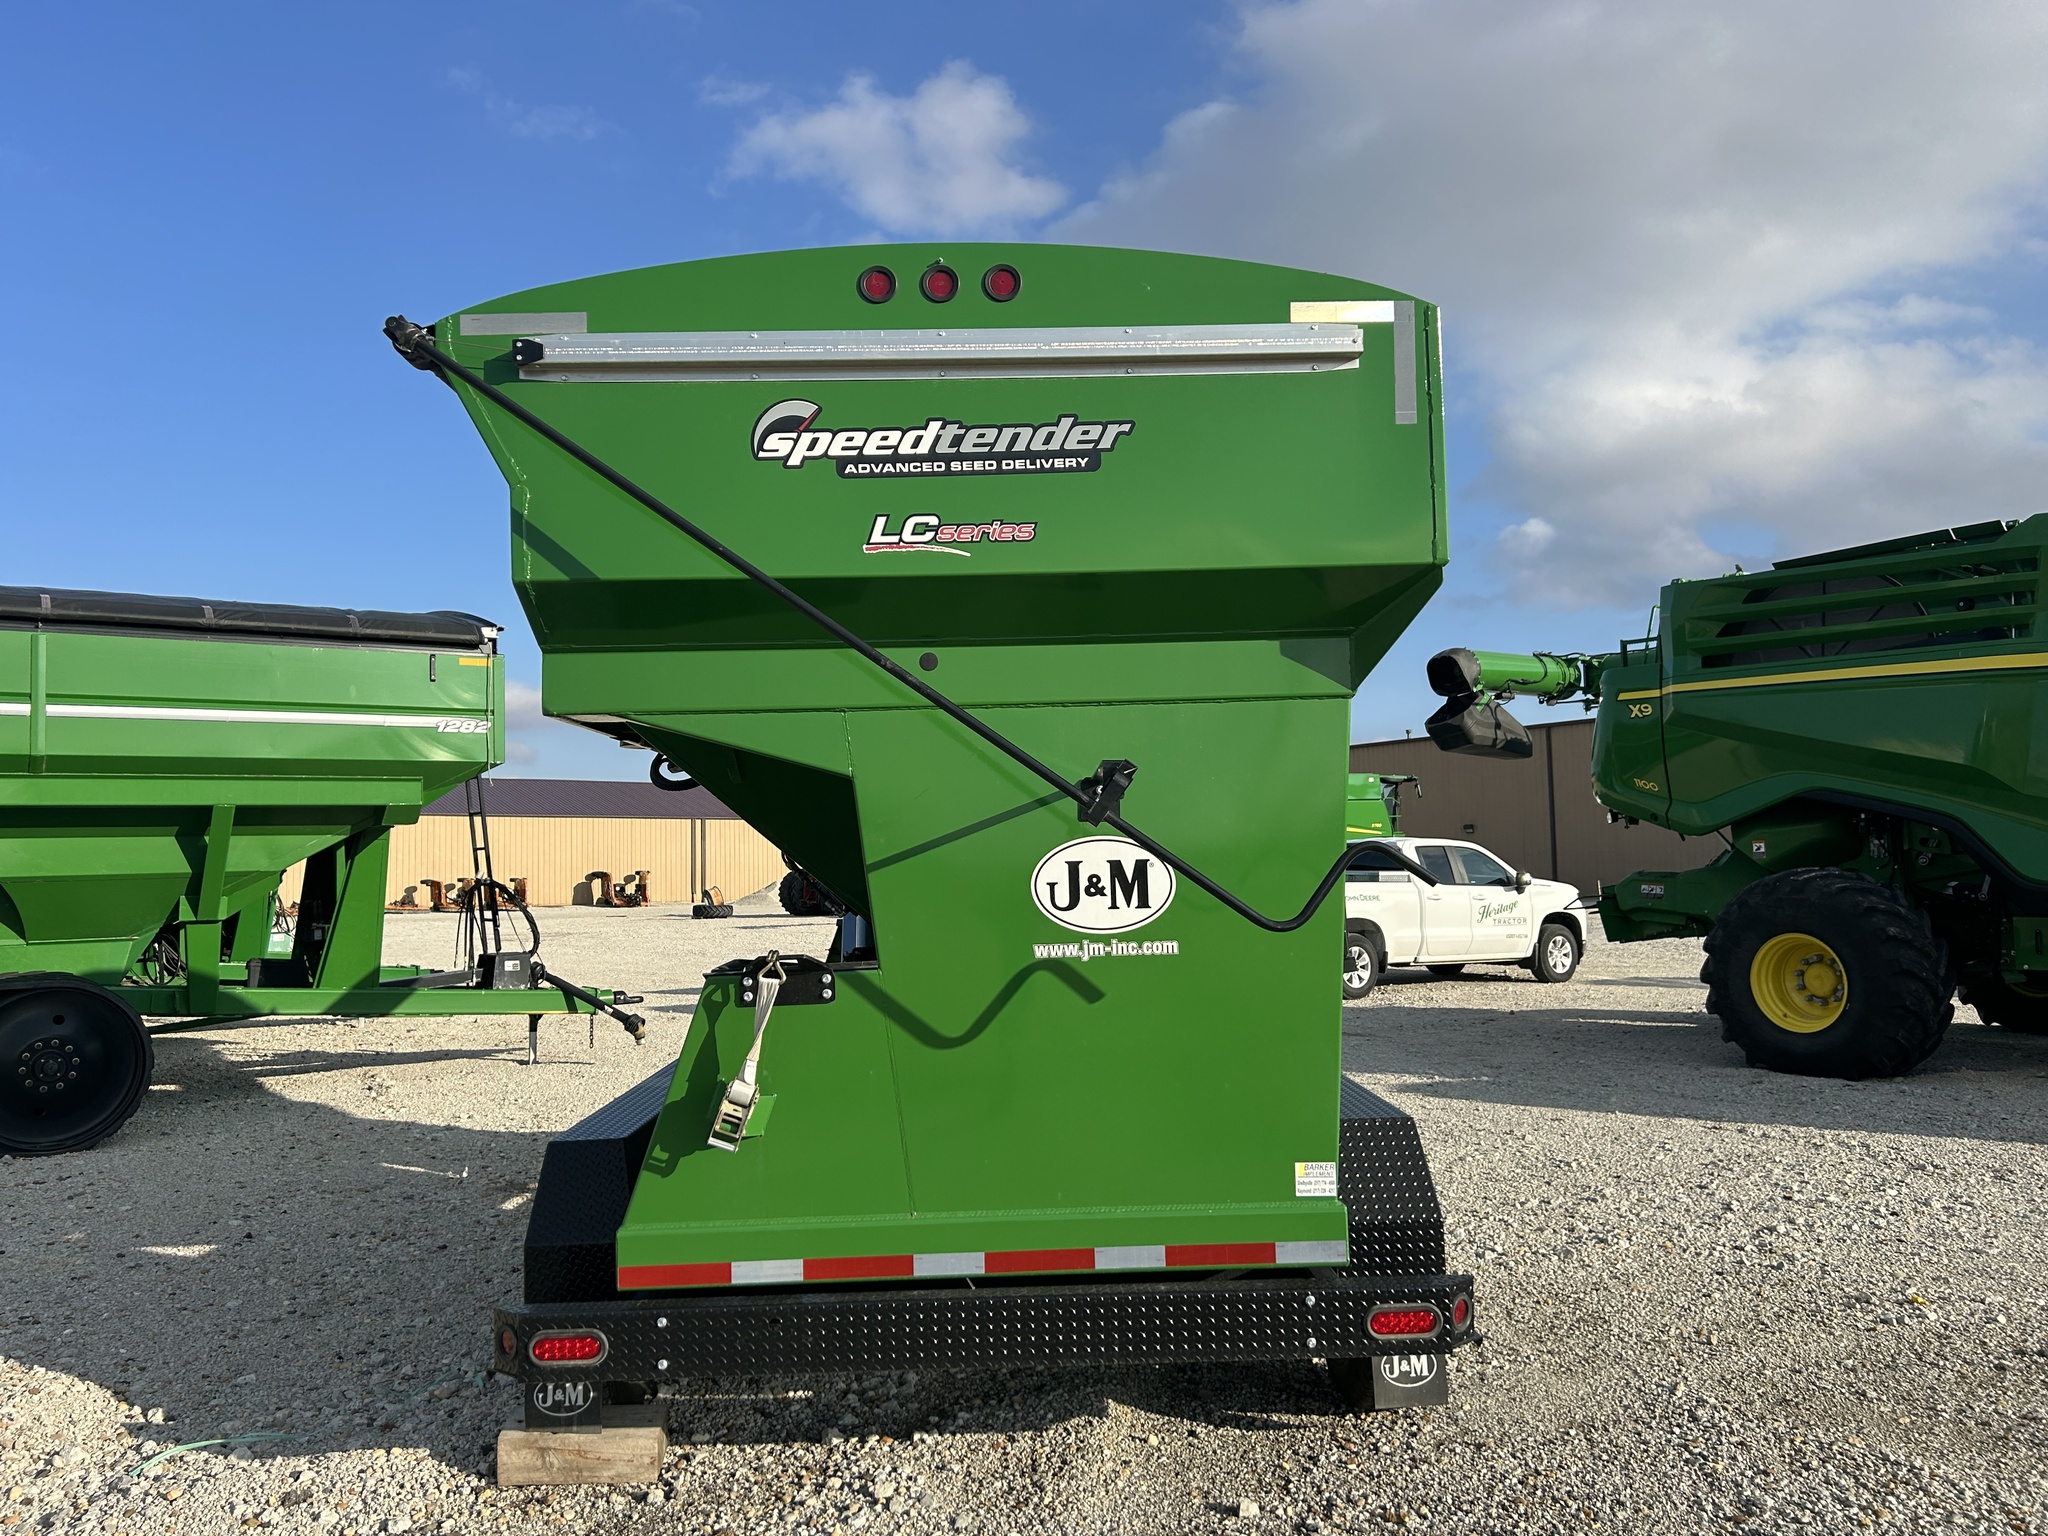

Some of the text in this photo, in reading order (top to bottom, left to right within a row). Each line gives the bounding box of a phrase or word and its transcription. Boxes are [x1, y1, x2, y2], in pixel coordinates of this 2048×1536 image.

[844, 457, 1090, 474] ADVANCED SEED DELIVERY
[1628, 703, 1653, 718] X9
[436, 719, 492, 734] 1282
[1633, 777, 1659, 791] 1100
[1046, 858, 1152, 912] J&M
[1477, 900, 1519, 924] Heritage
[1493, 917, 1527, 925] TRACTOR
[1033, 938, 1180, 962] www.jm-inc.com
[1384, 1354, 1429, 1378] J&M
[537, 1382, 585, 1407] J&M
